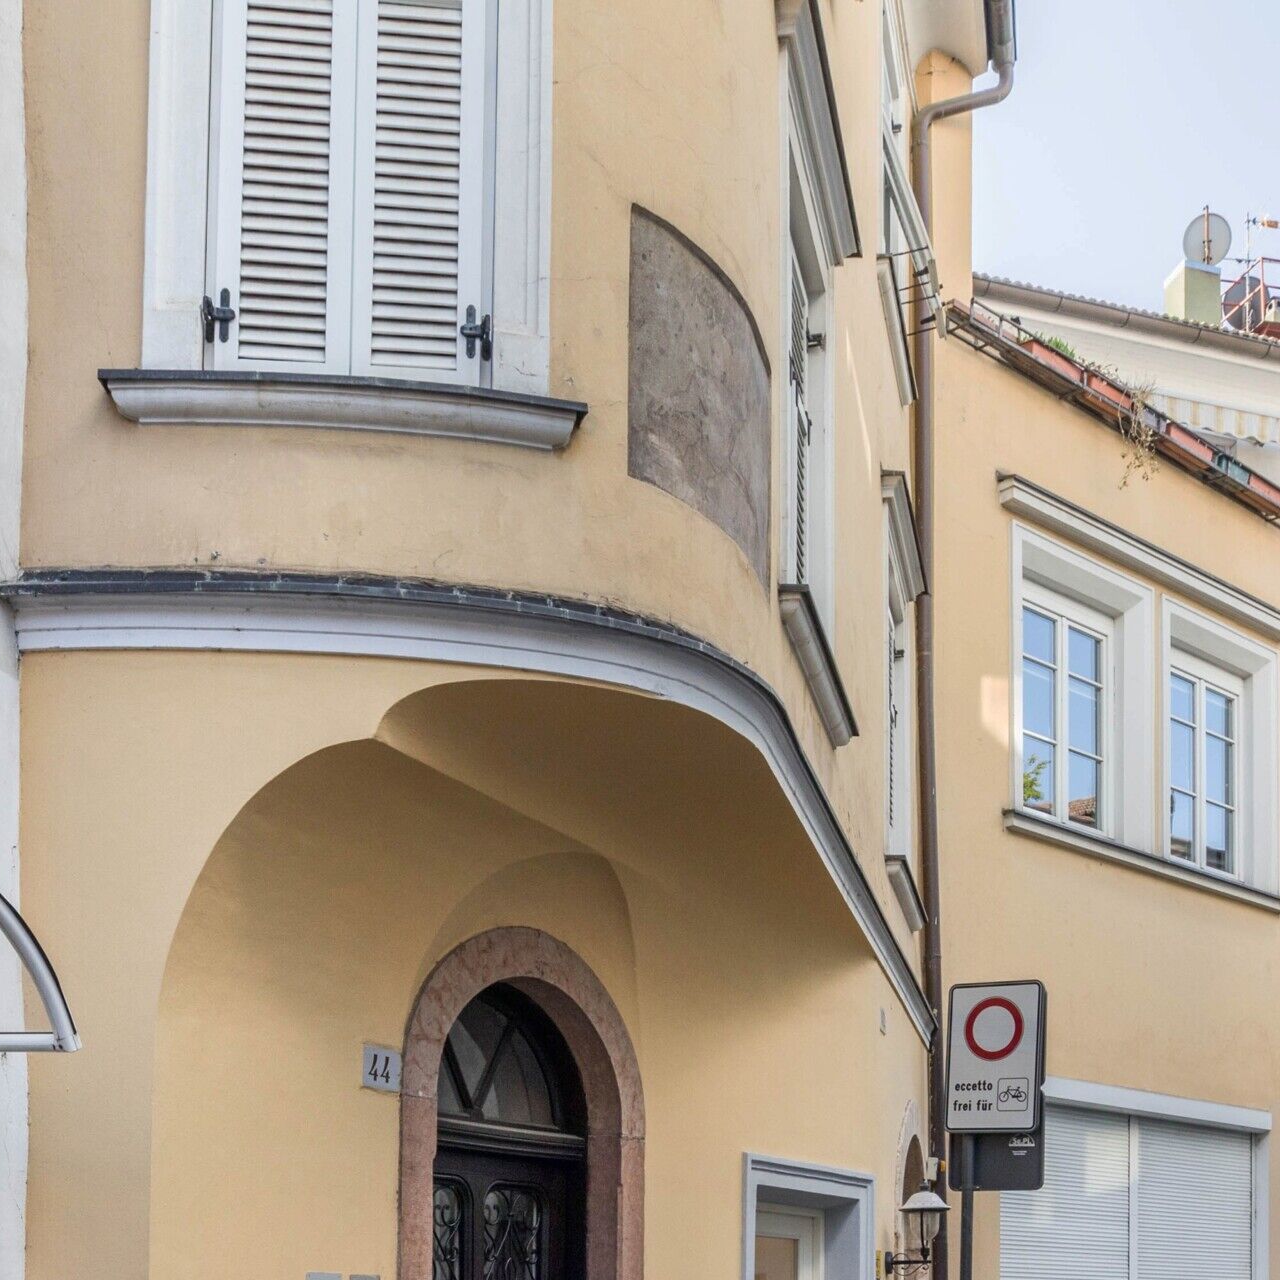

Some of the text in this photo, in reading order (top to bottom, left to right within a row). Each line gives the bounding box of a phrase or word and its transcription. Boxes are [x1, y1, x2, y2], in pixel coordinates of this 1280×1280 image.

[368, 1053, 390, 1083] 44
[954, 1079, 993, 1091] eccetto
[953, 1099, 993, 1112] frei für
